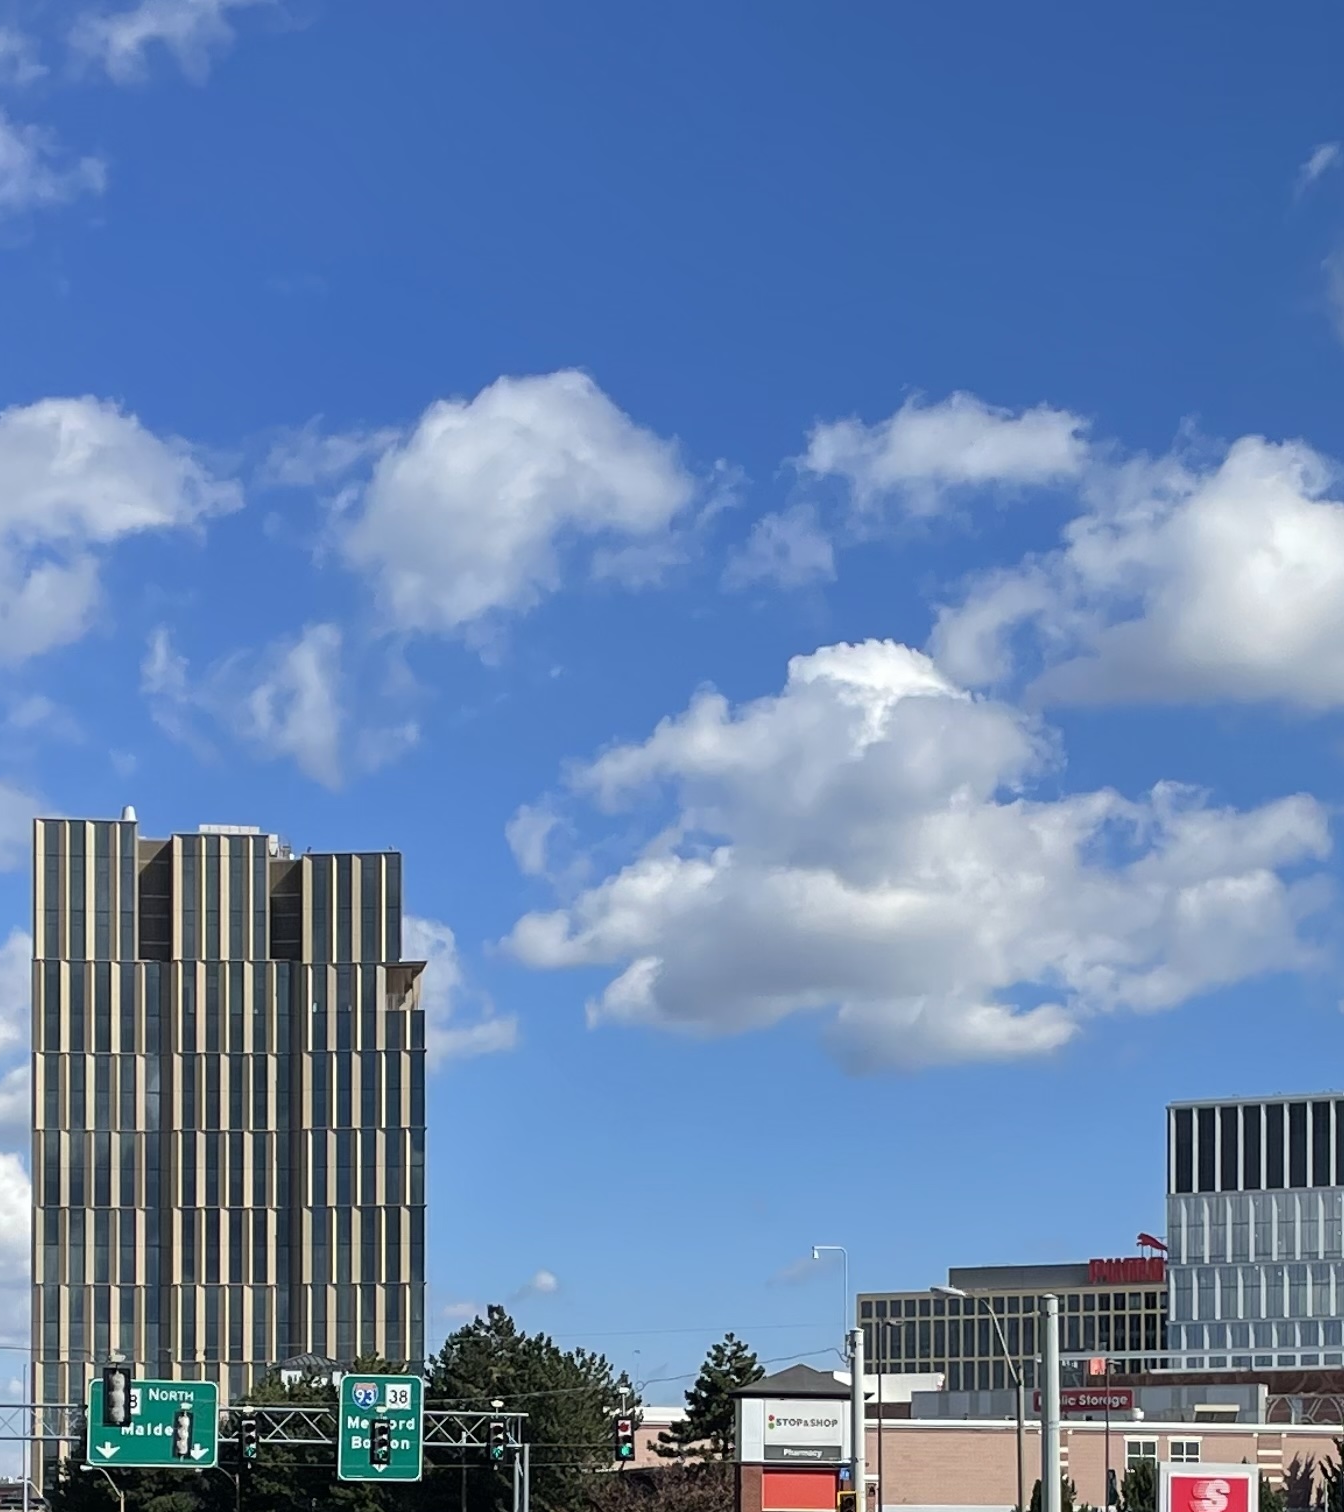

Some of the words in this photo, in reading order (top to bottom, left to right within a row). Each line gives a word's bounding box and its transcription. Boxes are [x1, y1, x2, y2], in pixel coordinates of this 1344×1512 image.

[148, 1388, 195, 1401] NORTH
[356, 1390, 375, 1404] 93
[389, 1390, 408, 1404] 38
[1078, 1394, 1128, 1408] Storage
[121, 1422, 174, 1436] Malde
[347, 1416, 415, 1430] Meord
[351, 1435, 410, 1449] Boon
[783, 1448, 823, 1459] Pharmacy
